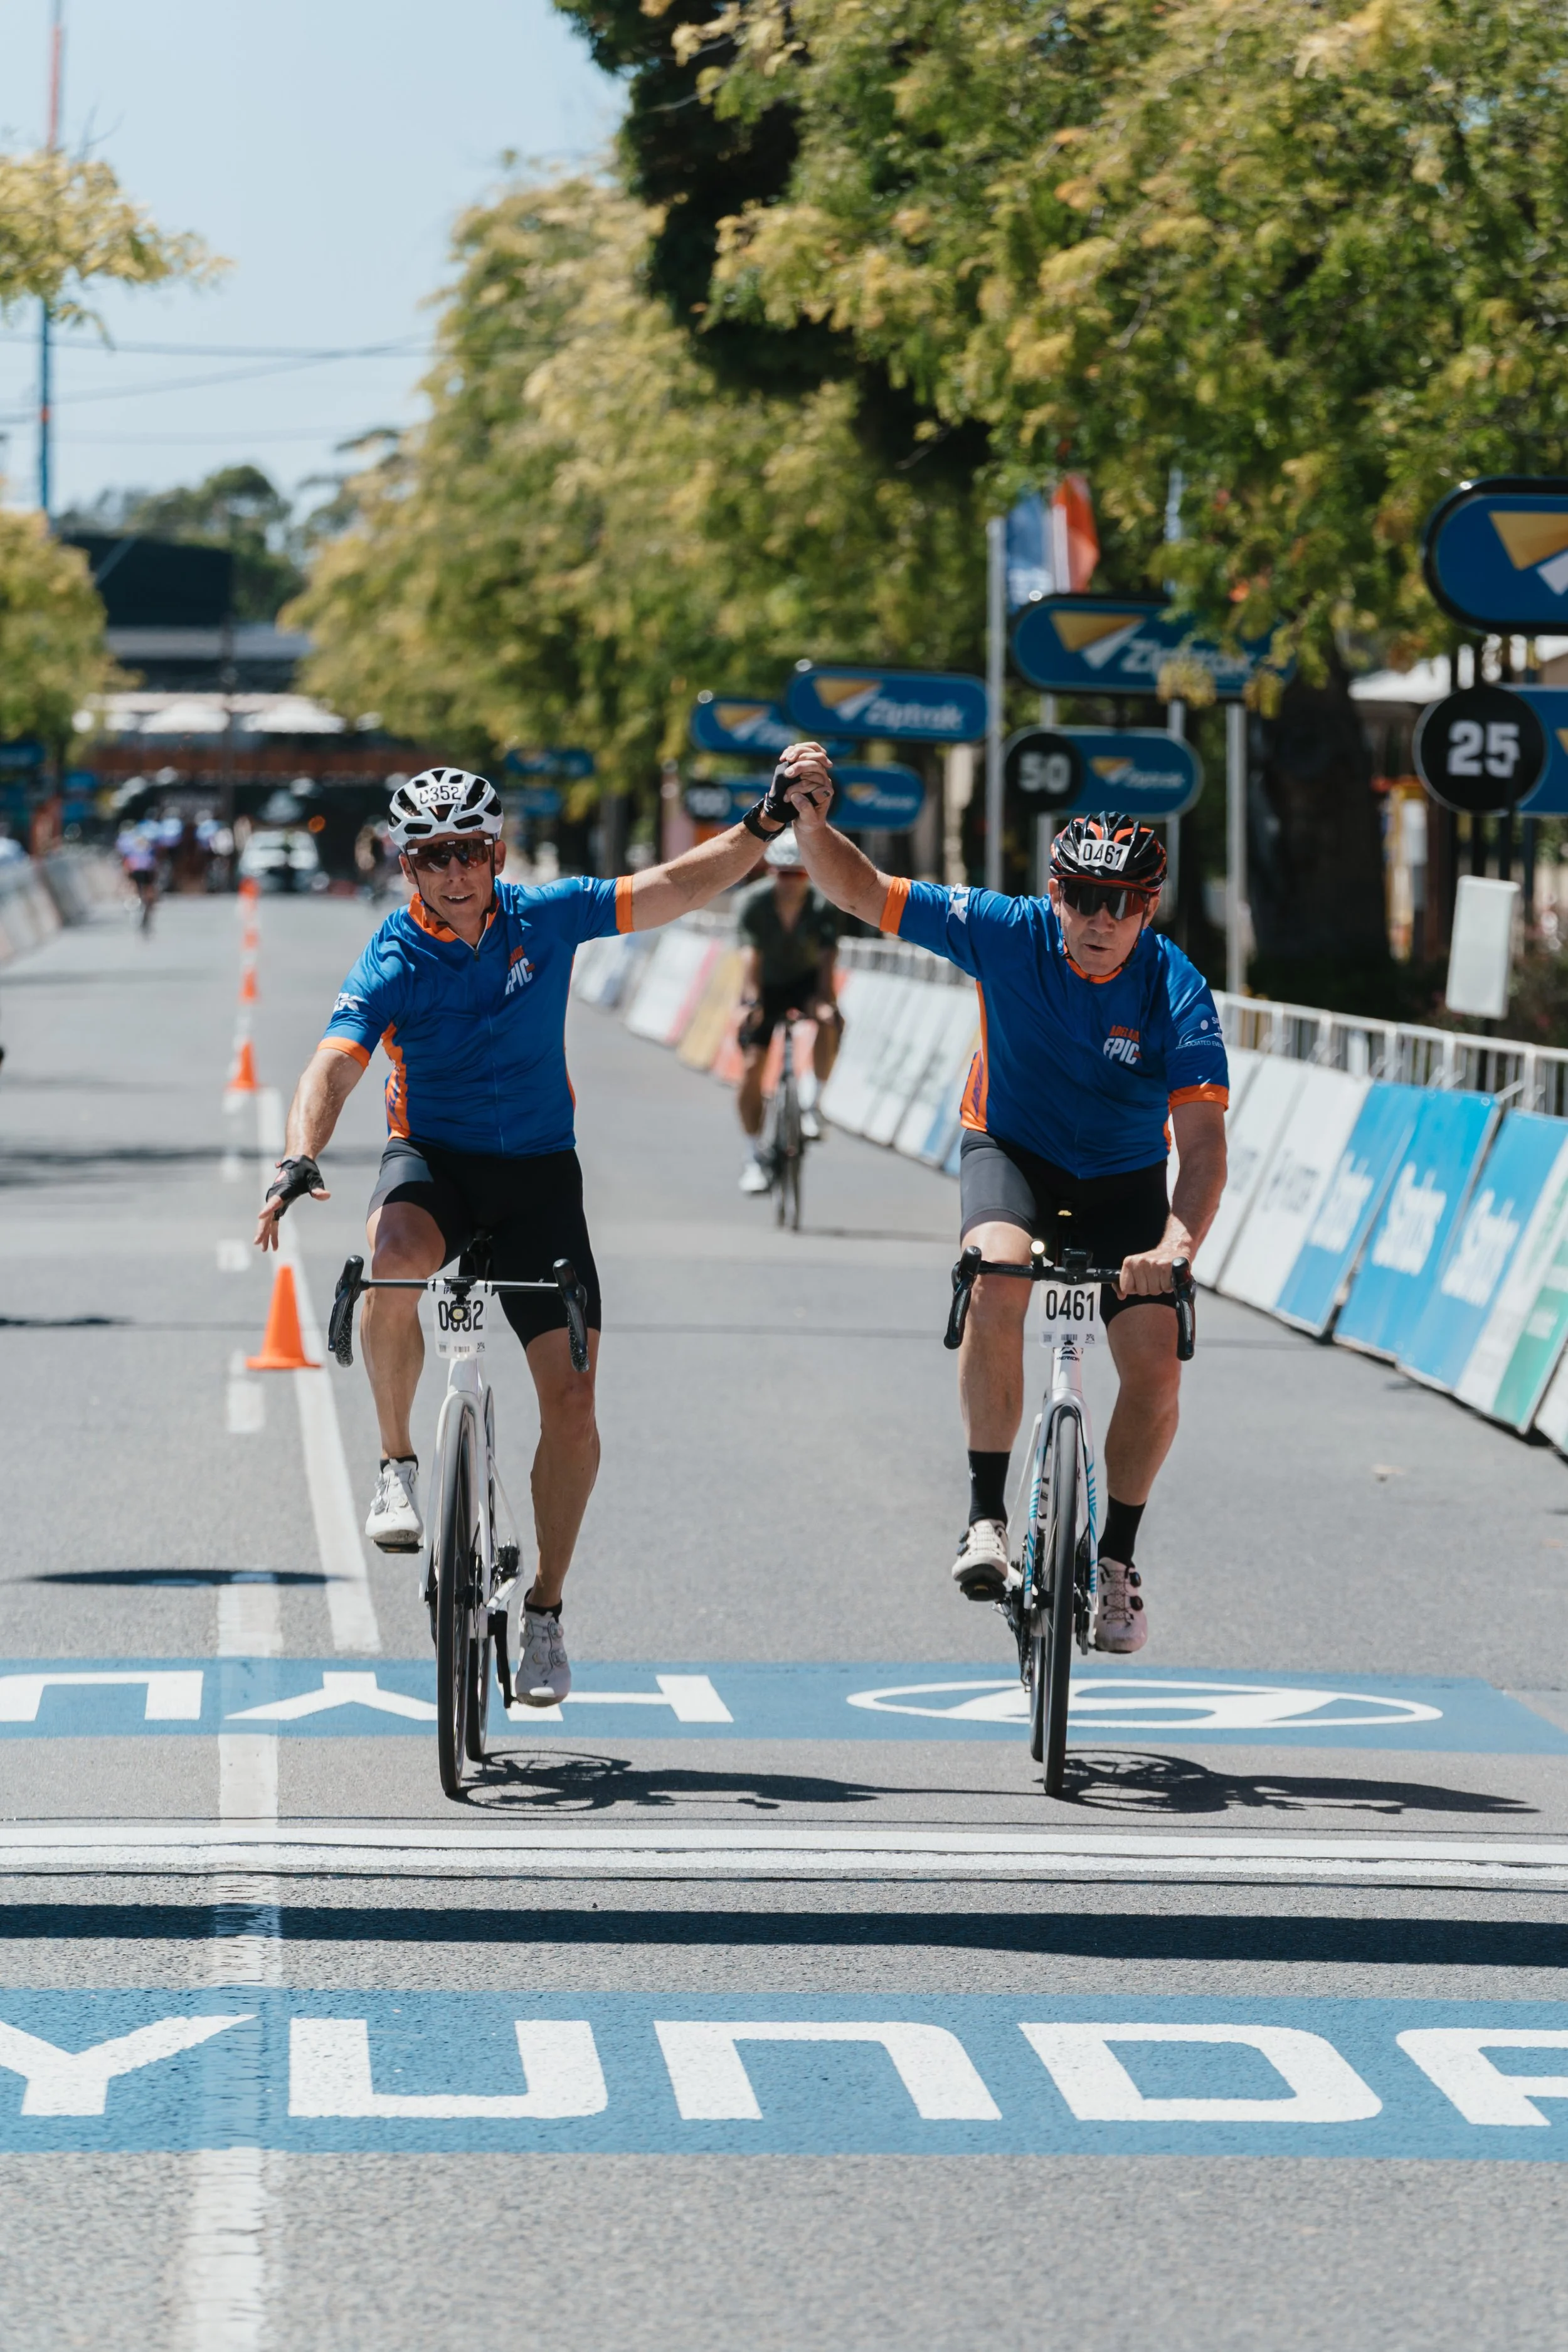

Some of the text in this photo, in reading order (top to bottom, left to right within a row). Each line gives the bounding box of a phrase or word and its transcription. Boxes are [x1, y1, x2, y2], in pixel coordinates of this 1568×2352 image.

[865, 697, 963, 732] Ziptrak
[1448, 719, 1520, 778] 25
[1018, 752, 1071, 794] 50
[1083, 843, 1123, 866] 0461
[506, 958, 532, 996] EPIC
[1103, 1037, 1140, 1065] EPIC
[1046, 1290, 1094, 1322] 0461
